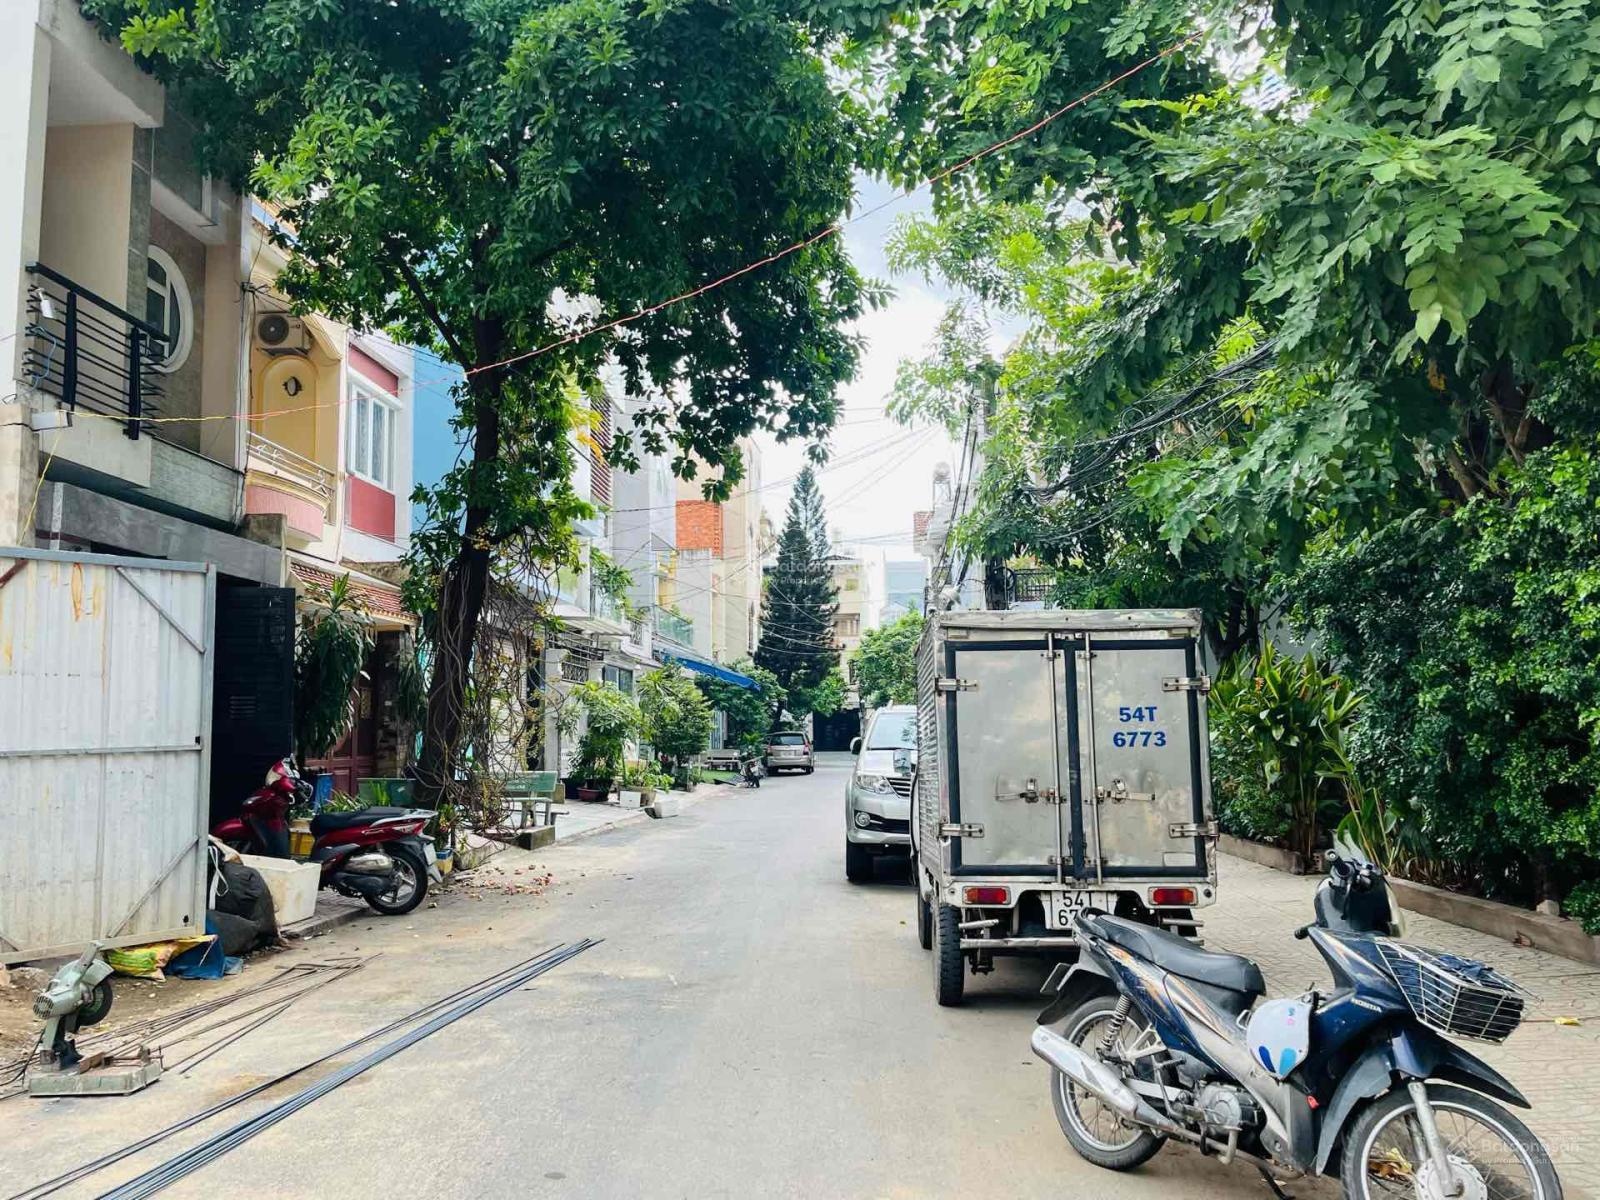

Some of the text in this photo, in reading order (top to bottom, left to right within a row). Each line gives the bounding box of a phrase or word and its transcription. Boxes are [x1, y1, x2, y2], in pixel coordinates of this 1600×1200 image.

[1119, 706, 1157, 722] 54T
[1113, 731, 1167, 747] 6773
[1062, 890, 1094, 907] 54T
[1058, 909, 1079, 926] 67
